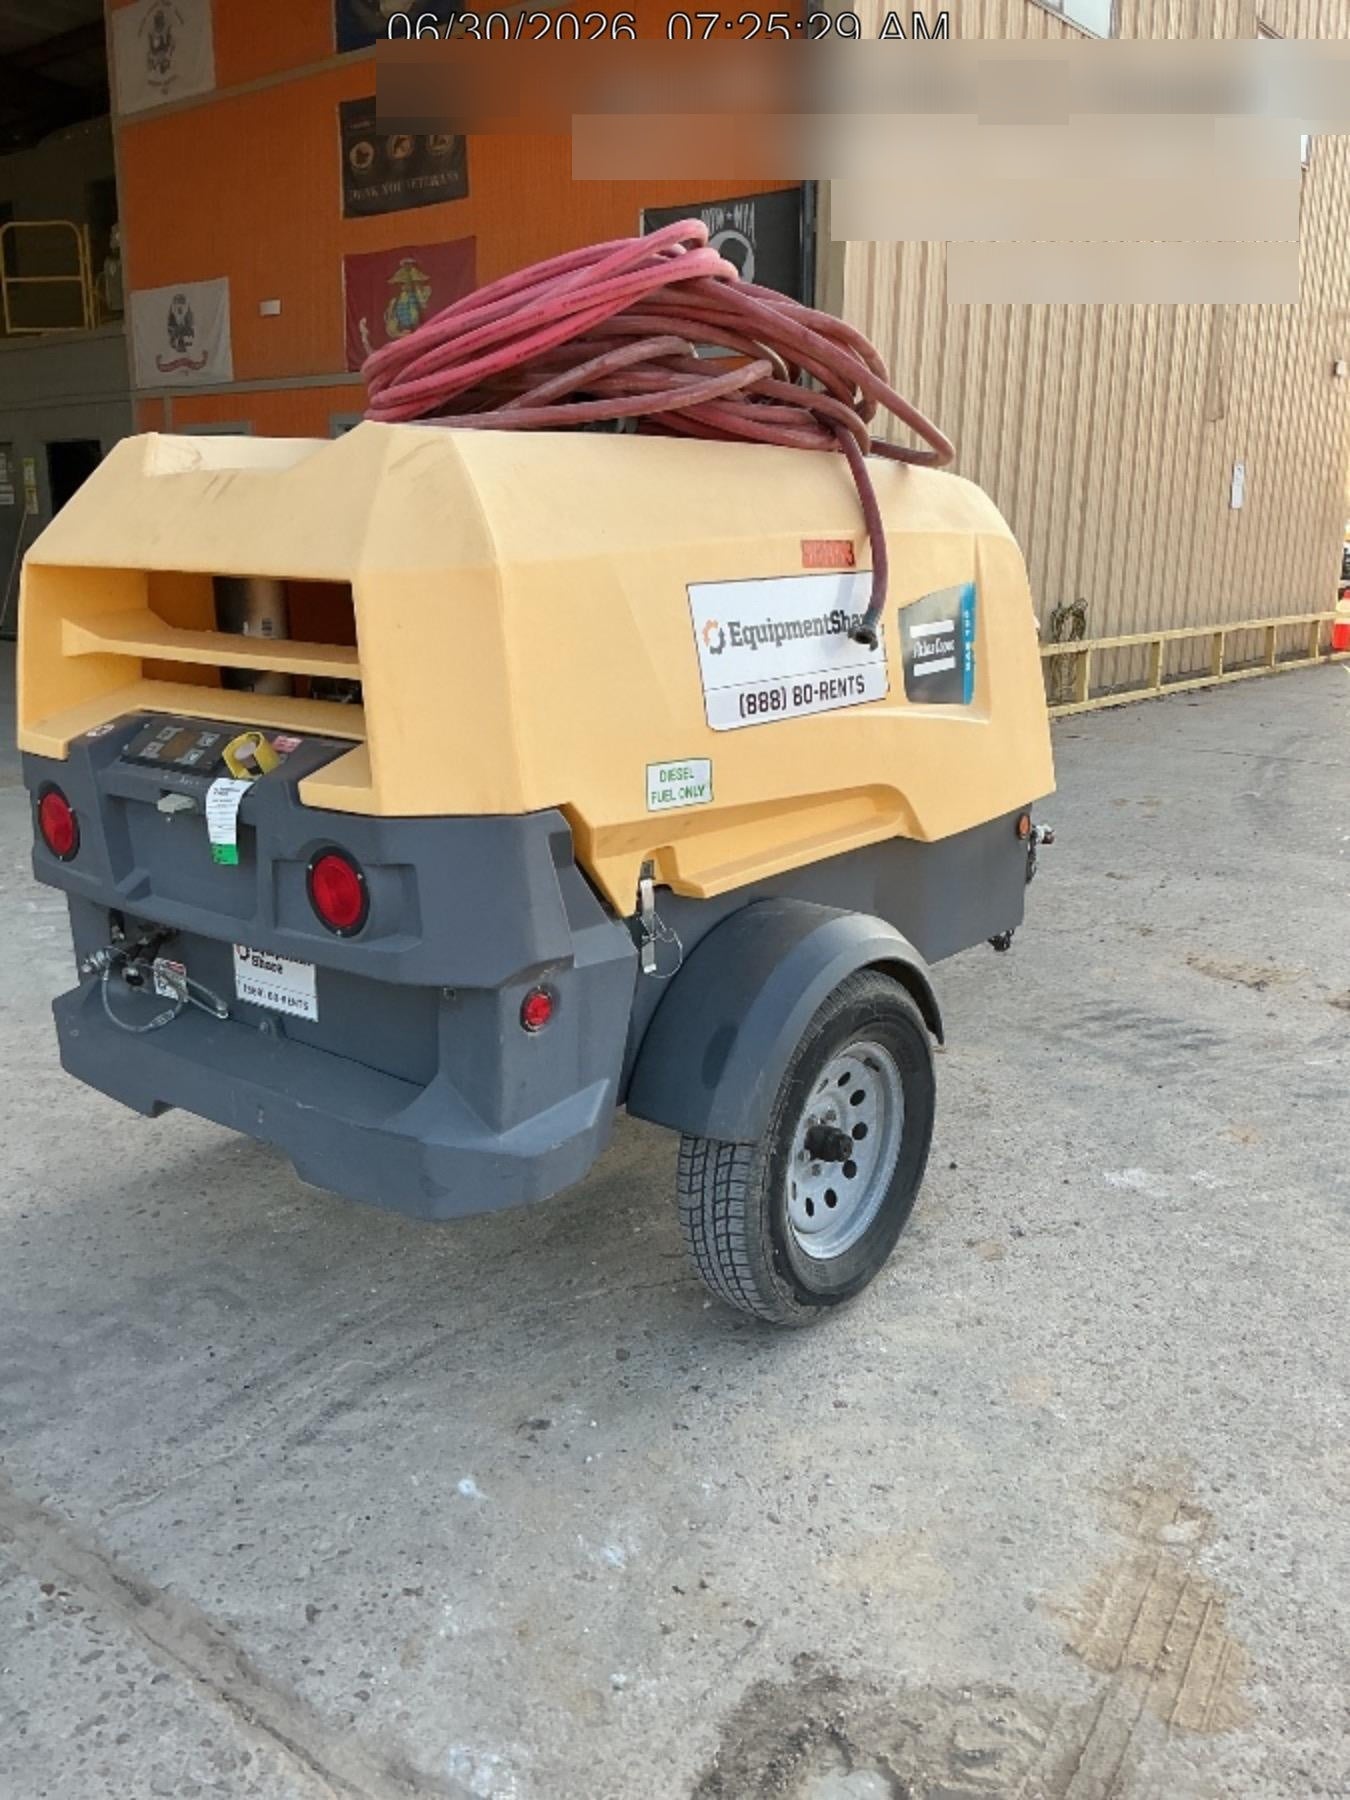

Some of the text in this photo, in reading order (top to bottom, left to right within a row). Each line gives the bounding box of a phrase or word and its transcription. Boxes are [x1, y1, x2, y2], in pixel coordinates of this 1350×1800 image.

[727, 609, 867, 651] EquipmentSha
[739, 674, 866, 718] (888) 80-RENTS
[659, 767, 695, 783] DIESEL
[651, 785, 705, 804] FUEL ONLY
